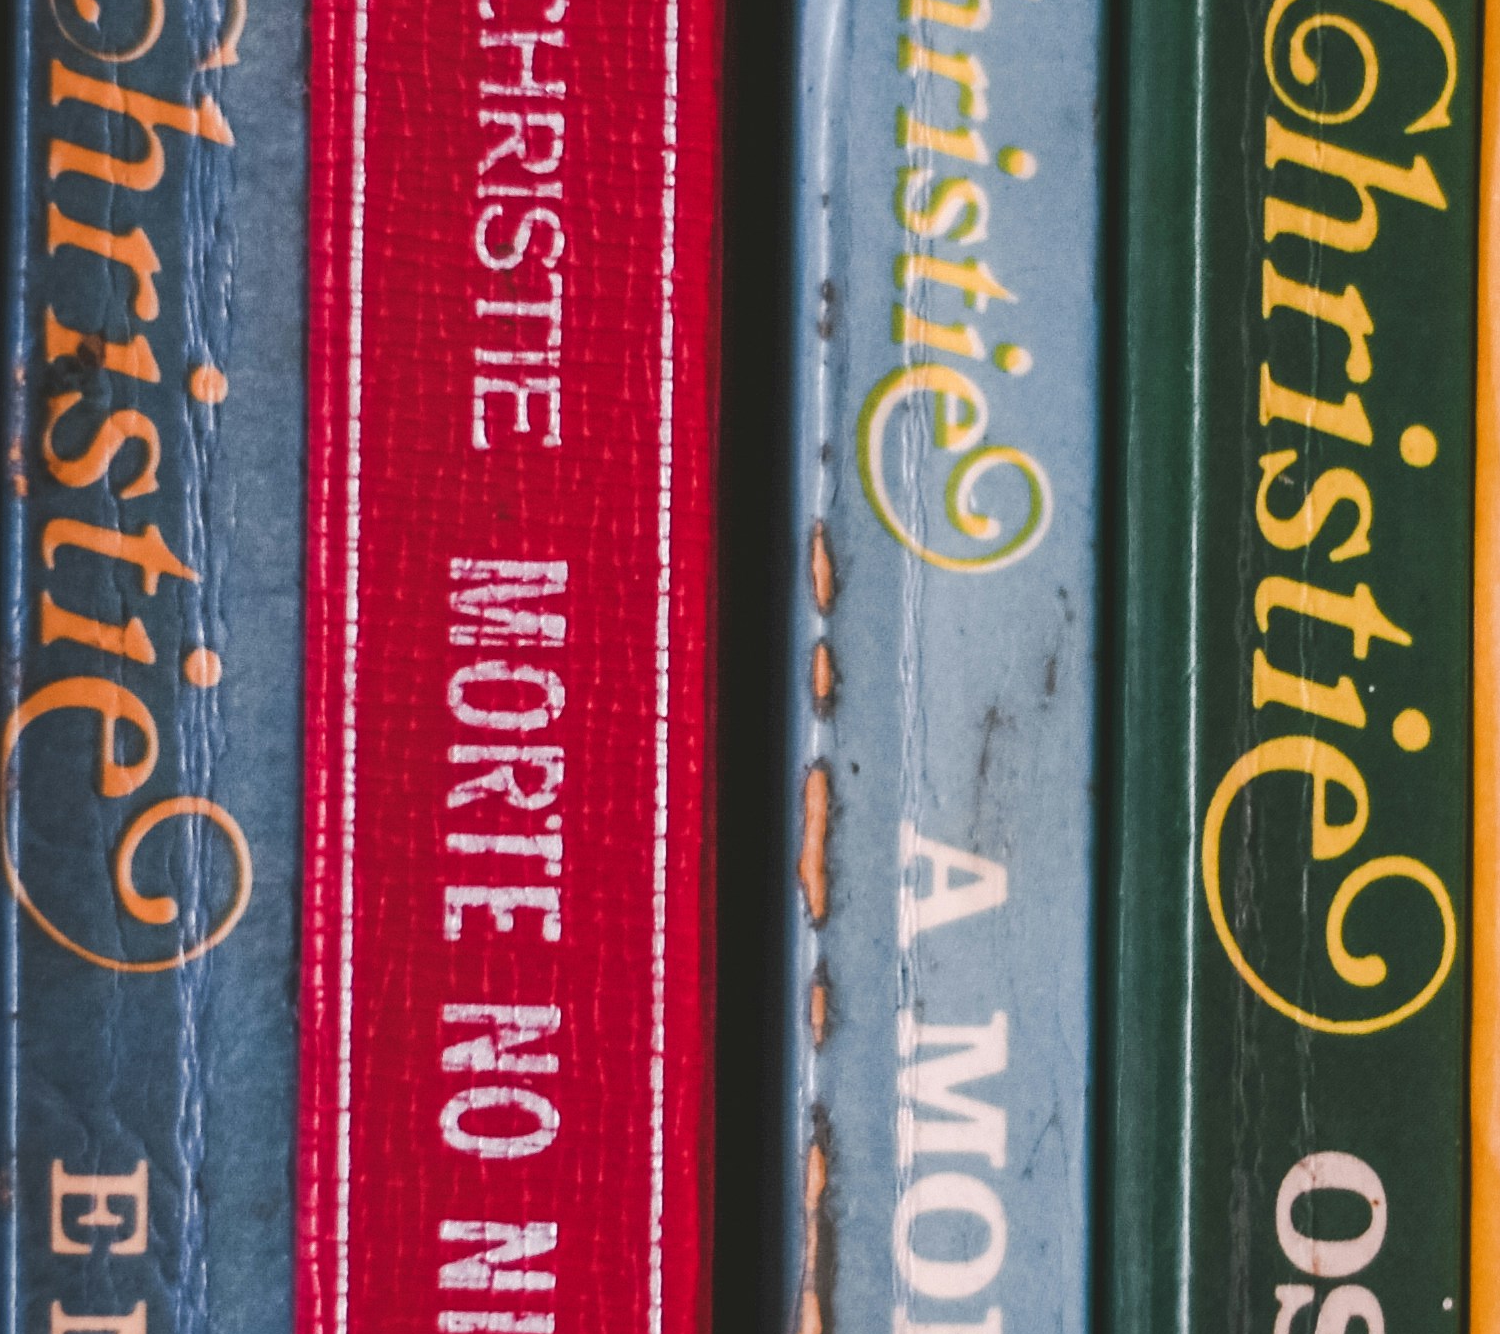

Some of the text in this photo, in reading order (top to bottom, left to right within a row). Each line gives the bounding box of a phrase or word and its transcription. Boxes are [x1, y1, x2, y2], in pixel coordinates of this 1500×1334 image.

[443, 557, 568, 942] MORTE
[898, 819, 1008, 950] A
[439, 1002, 562, 1161] NO
[50, 1158, 150, 1257] E
